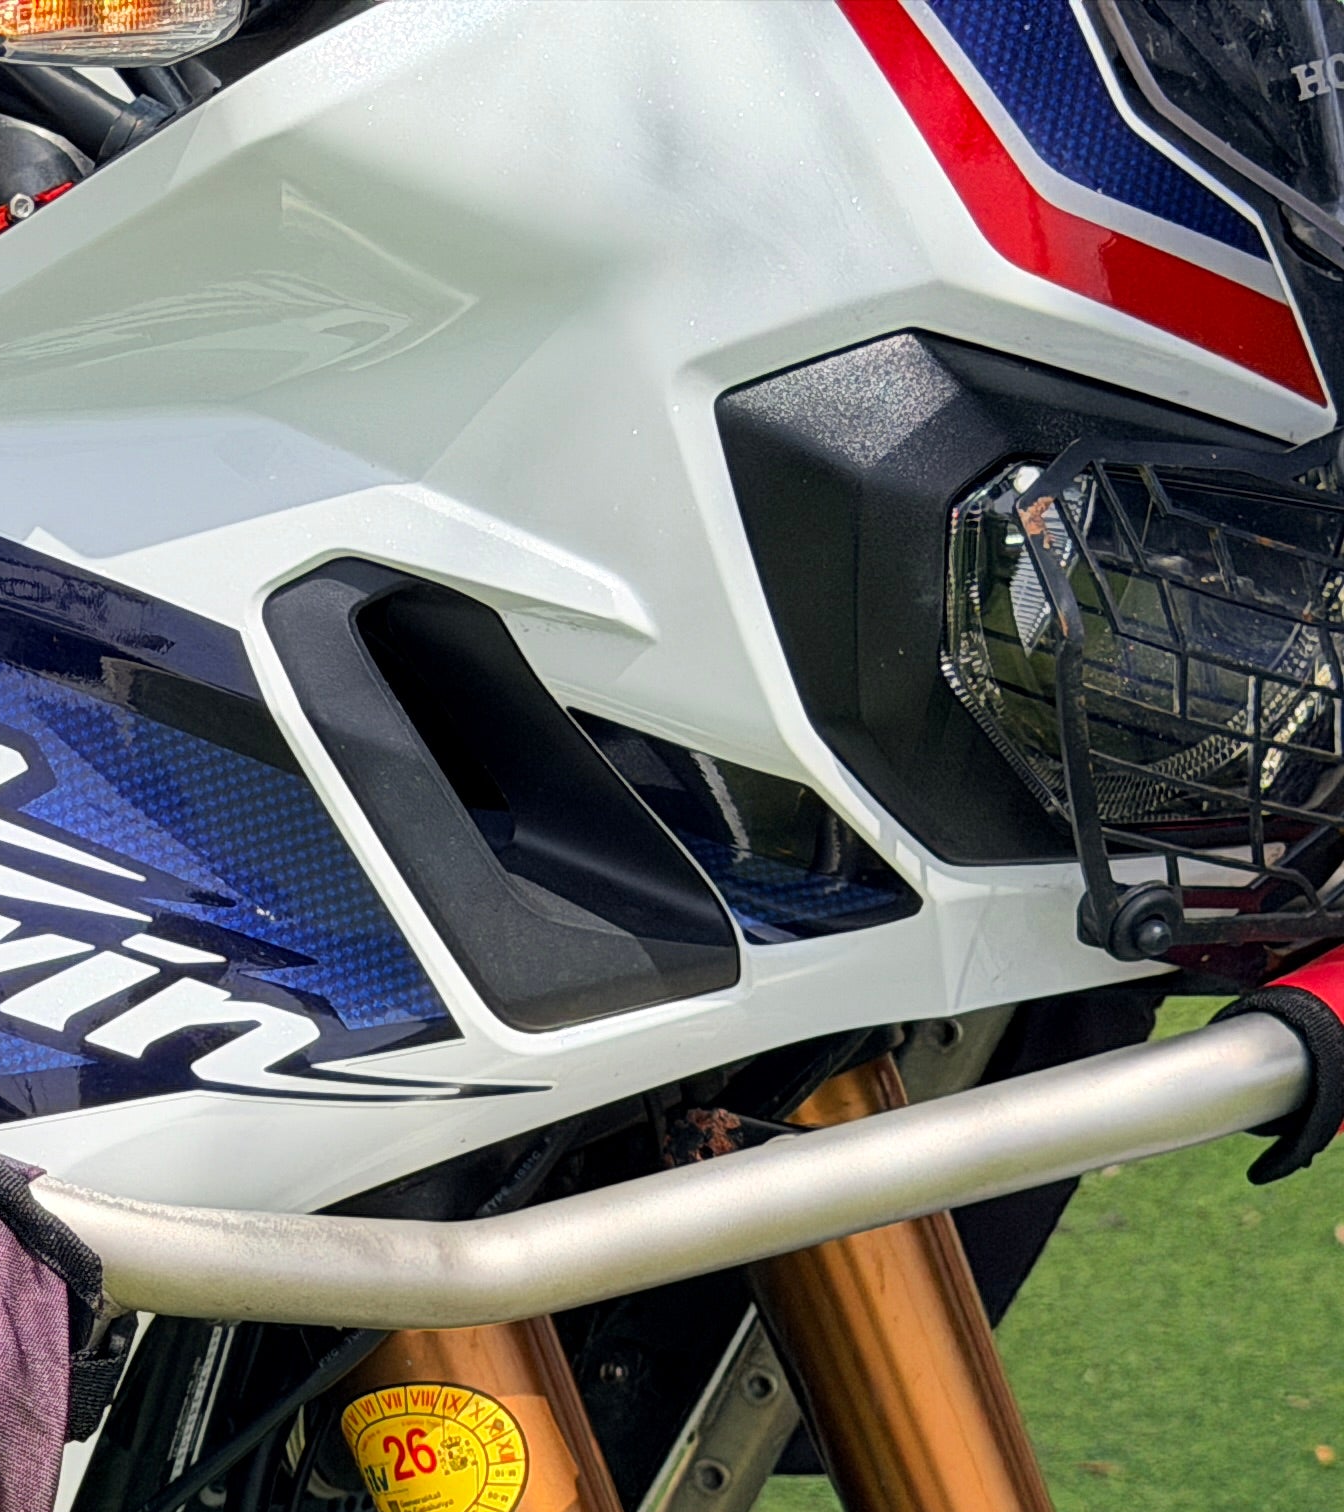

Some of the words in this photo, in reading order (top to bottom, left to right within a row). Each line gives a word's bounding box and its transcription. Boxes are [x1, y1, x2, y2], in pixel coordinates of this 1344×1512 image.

[359, 1399, 376, 1417] VI
[381, 1391, 402, 1410] VII
[409, 1389, 435, 1408] VIII
[442, 1392, 463, 1413] IX
[469, 1400, 486, 1421] X
[382, 1427, 438, 1482] 26
